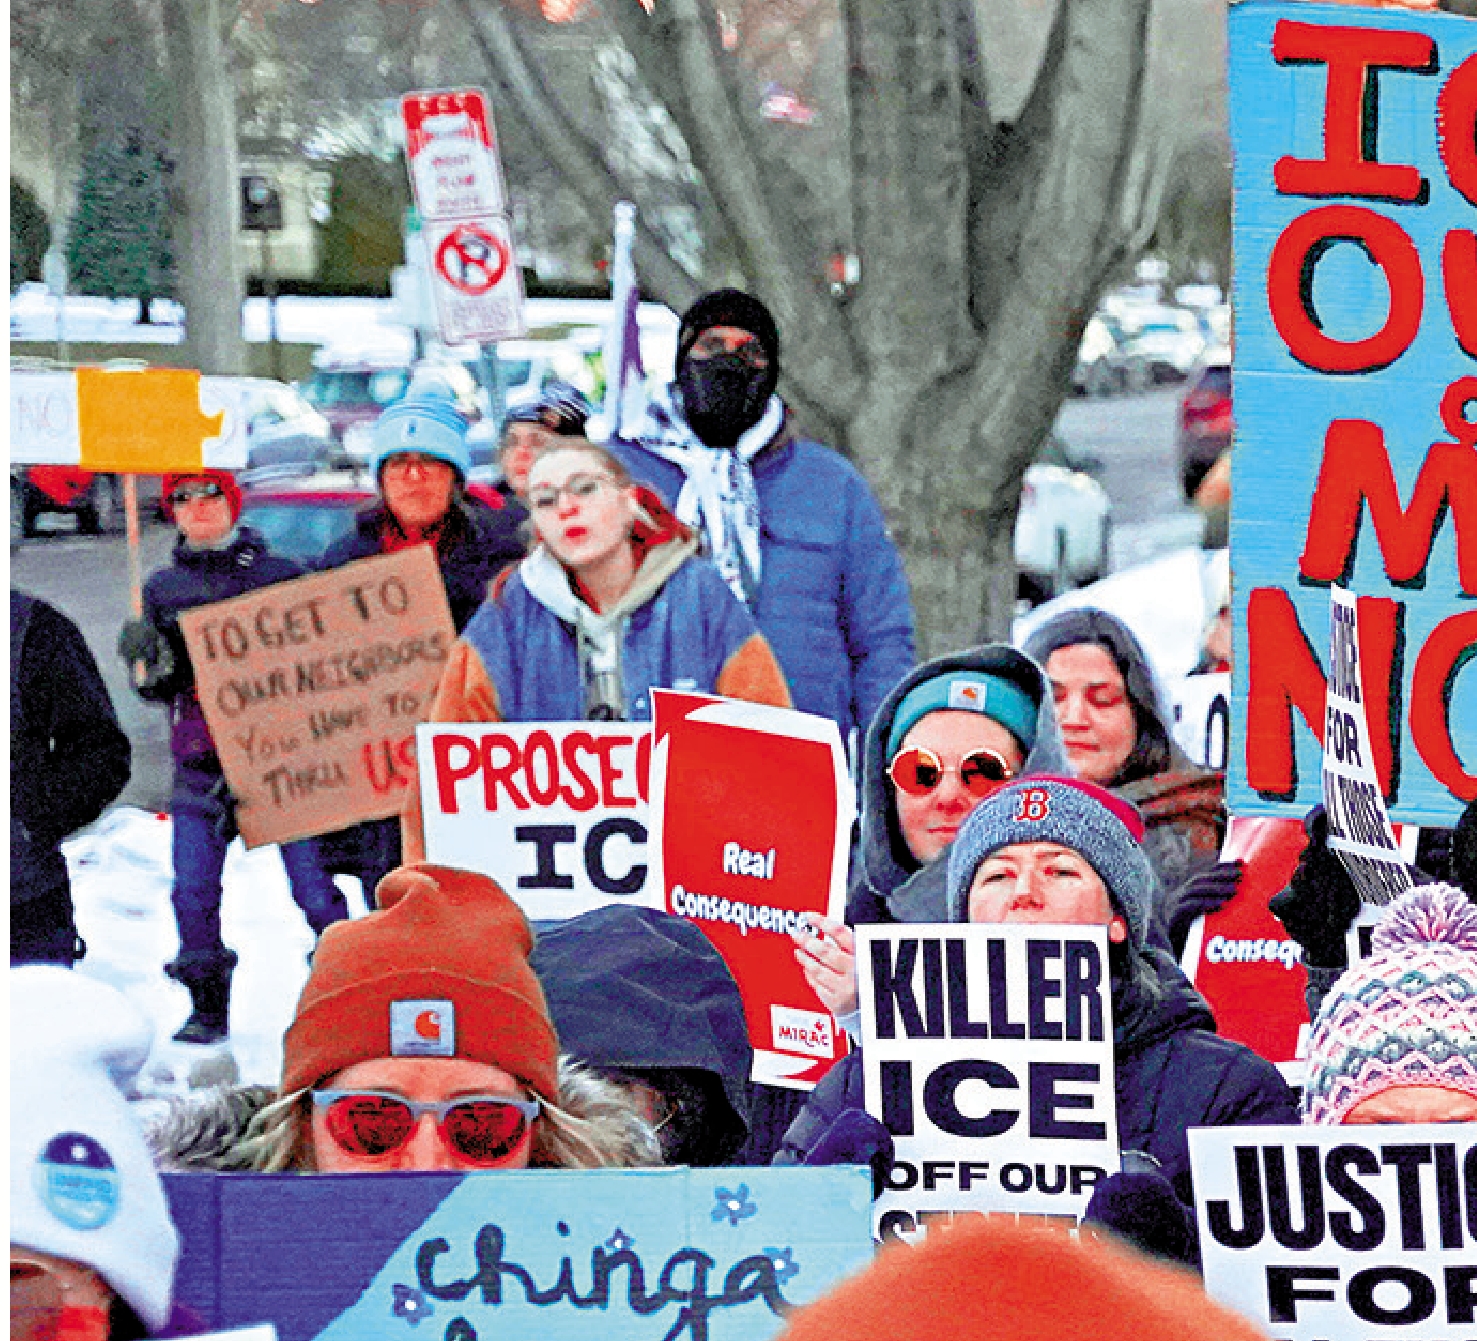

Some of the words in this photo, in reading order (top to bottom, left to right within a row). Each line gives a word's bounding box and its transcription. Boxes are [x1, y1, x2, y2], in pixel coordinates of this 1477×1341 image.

[200, 615, 249, 661] TO
[345, 575, 409, 622] TO
[1013, 787, 1051, 822] B
[723, 841, 777, 881] Real
[671, 884, 820, 938] Consequence
[869, 938, 1105, 1042] KILLER
[879, 1059, 1108, 1141] ICE
[885, 1161, 990, 1192] OFF
